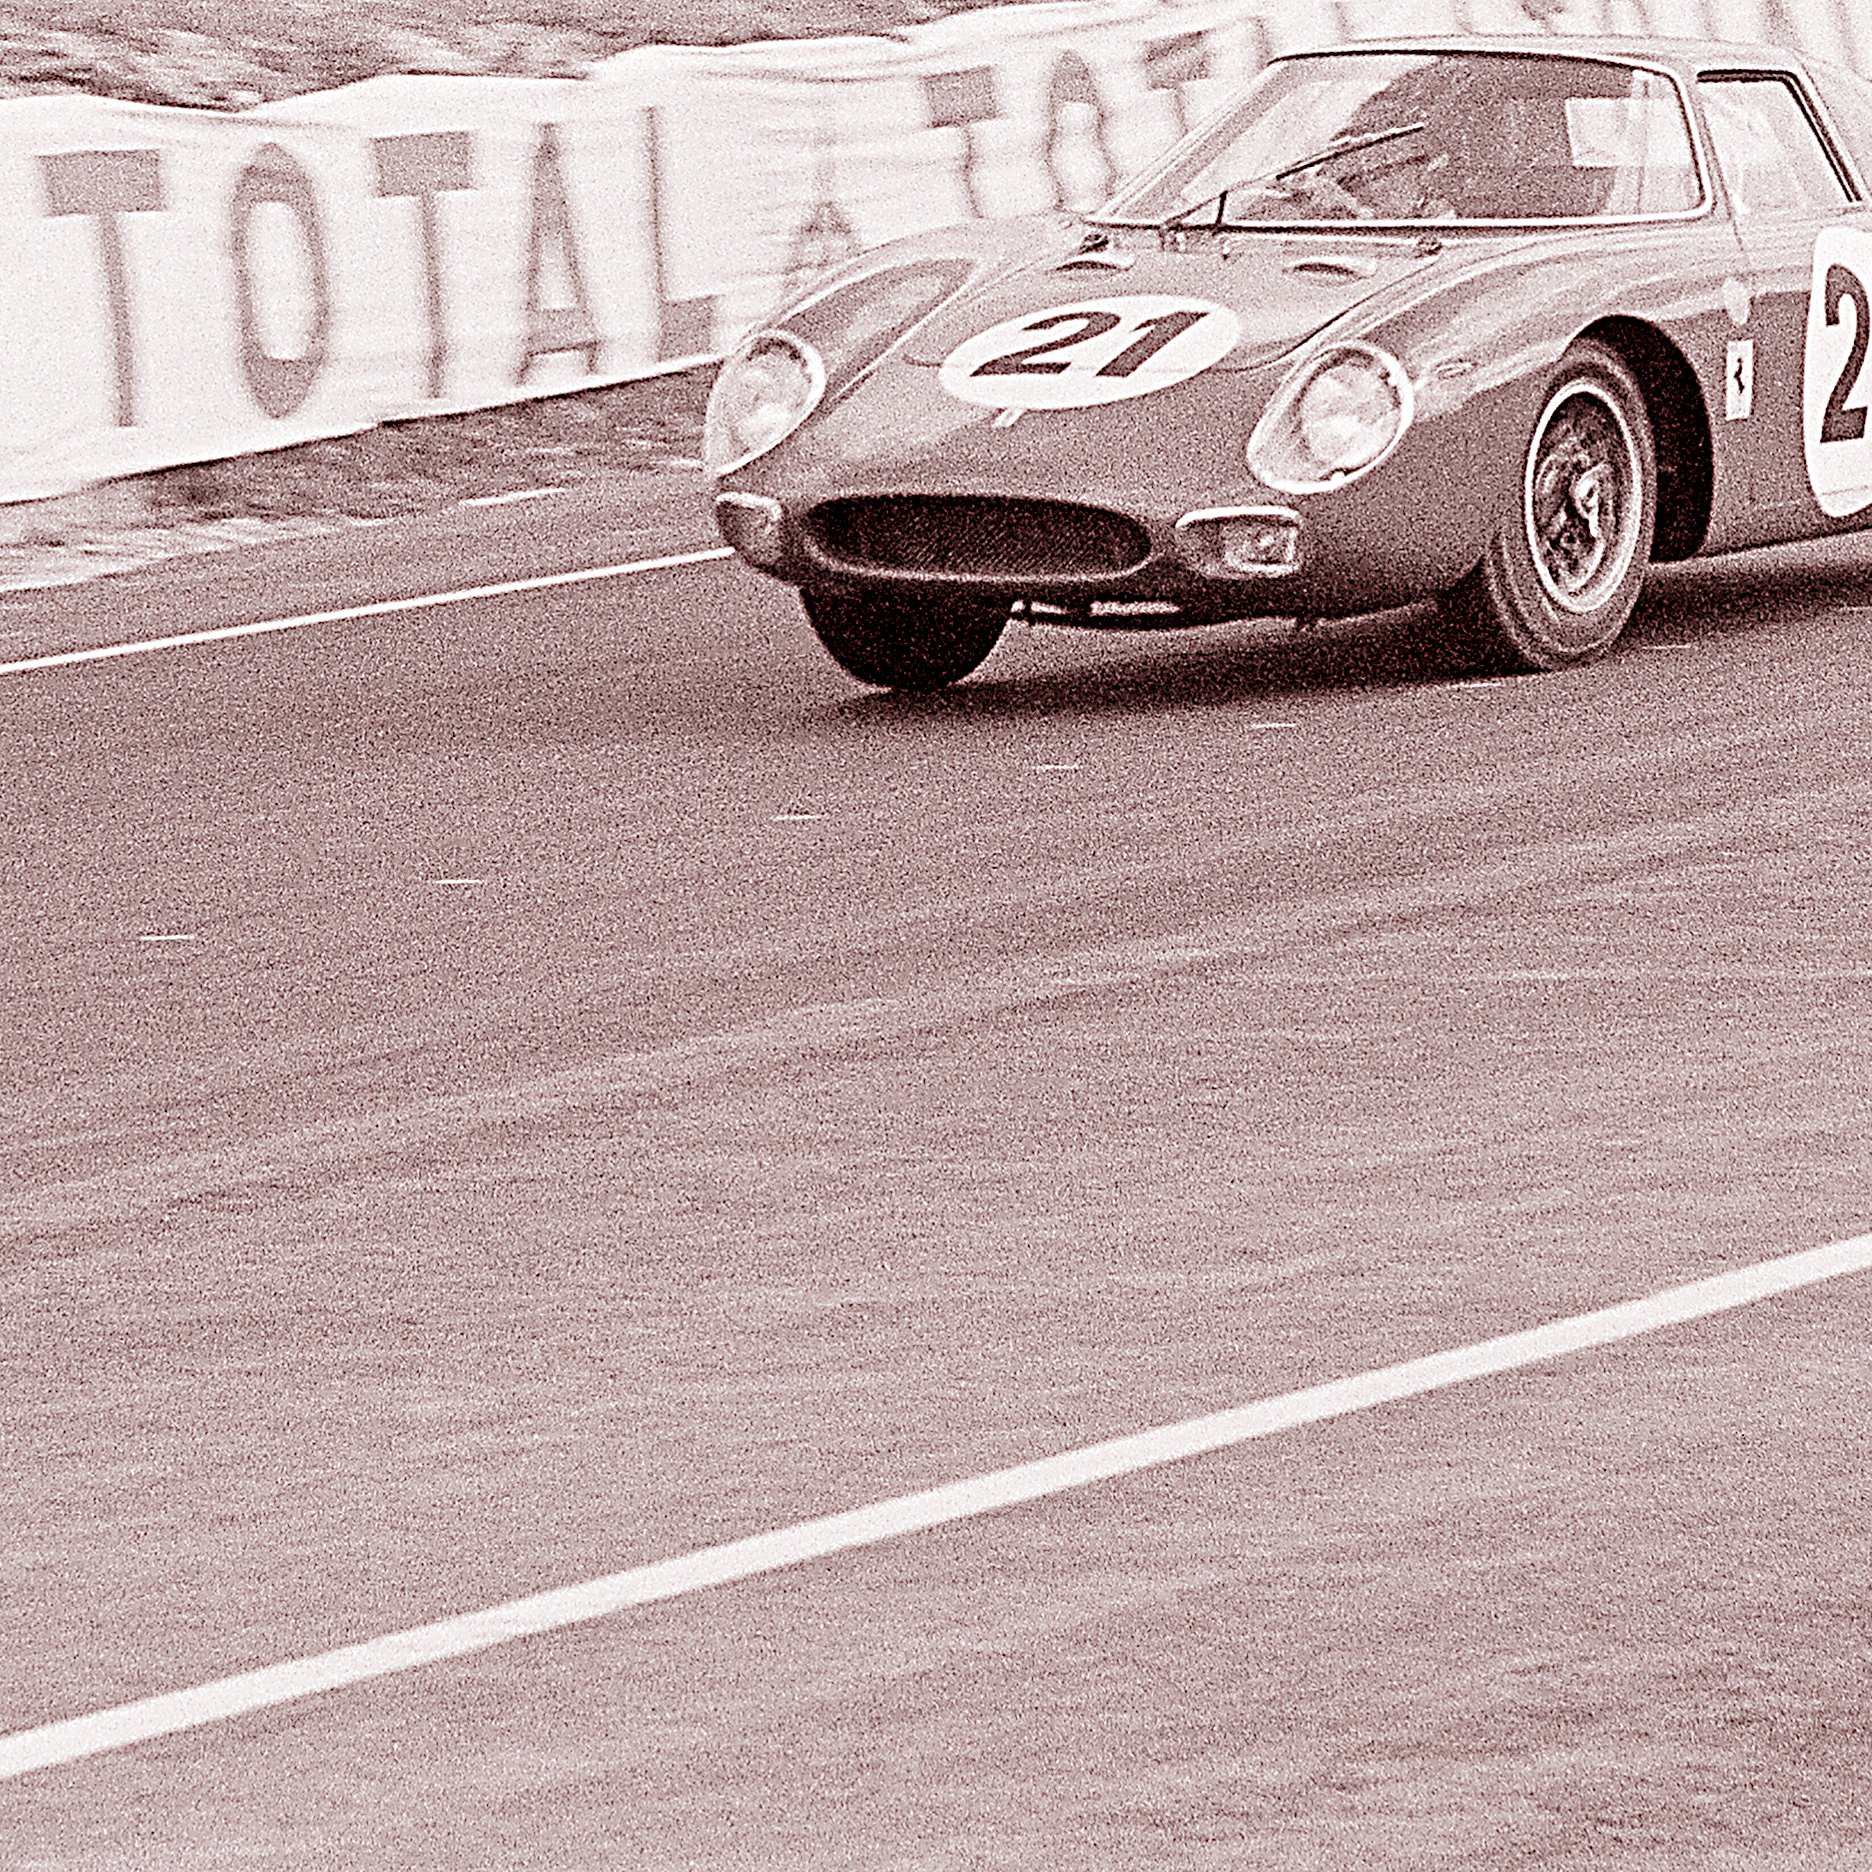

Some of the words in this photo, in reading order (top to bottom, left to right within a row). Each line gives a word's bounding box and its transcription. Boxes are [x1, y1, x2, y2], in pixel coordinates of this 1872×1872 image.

[923, 1, 1356, 224] TOT
[34, 104, 722, 428] TOTAL
[970, 312, 1210, 378] 21
